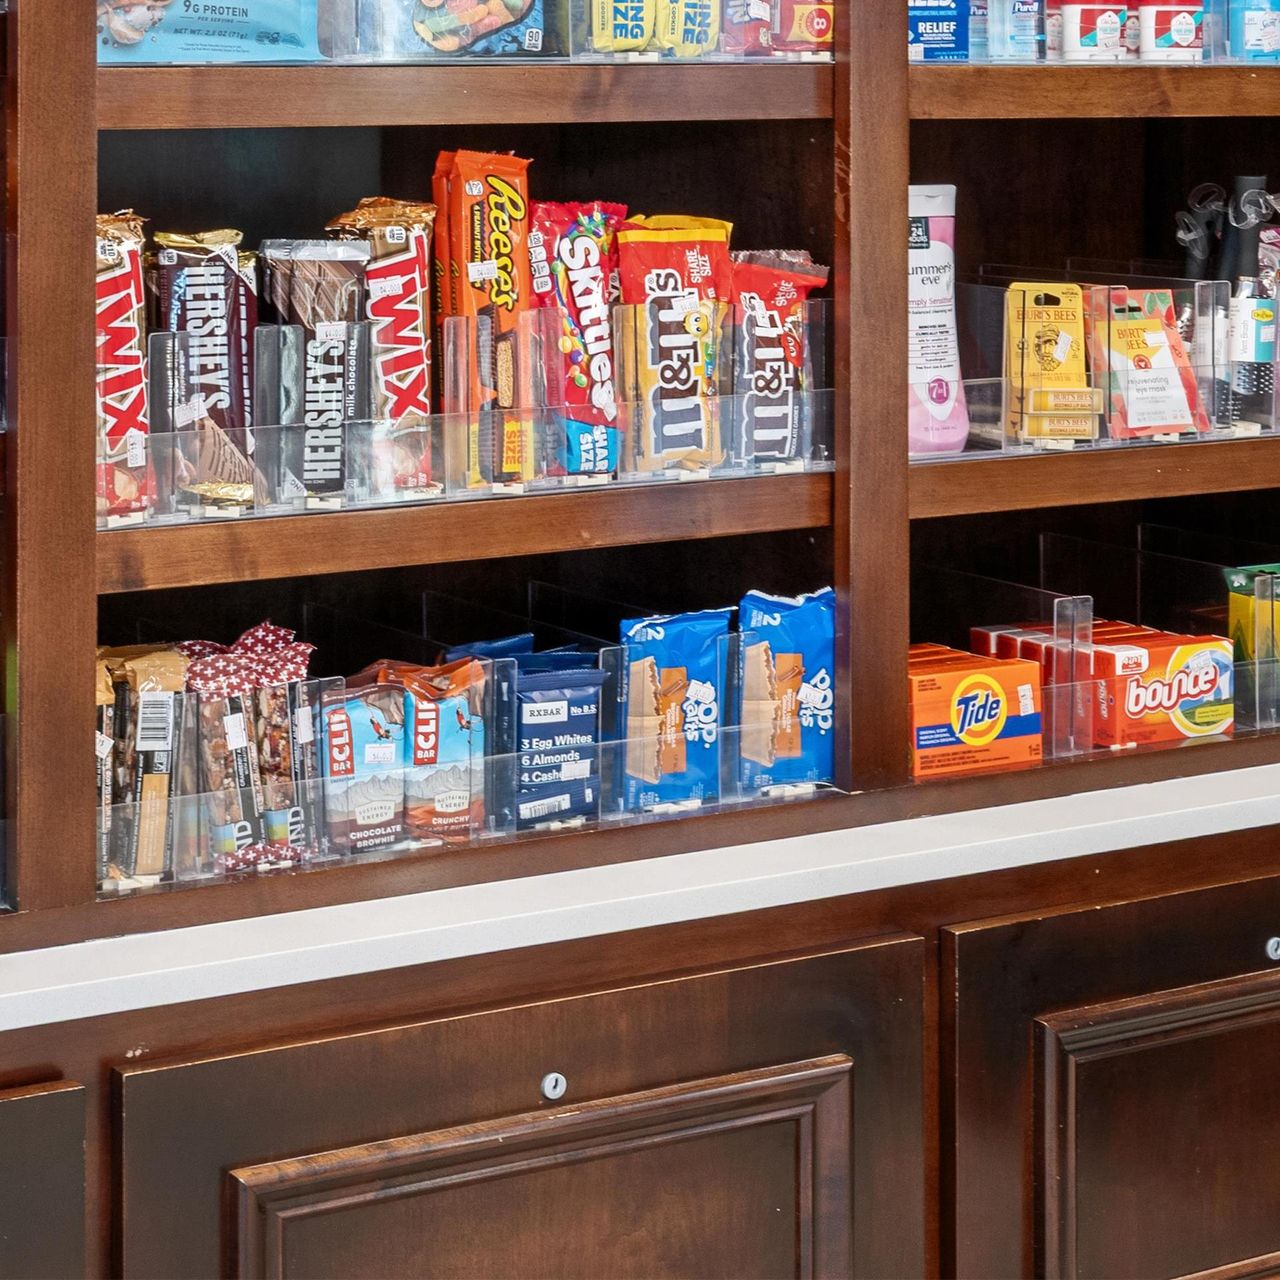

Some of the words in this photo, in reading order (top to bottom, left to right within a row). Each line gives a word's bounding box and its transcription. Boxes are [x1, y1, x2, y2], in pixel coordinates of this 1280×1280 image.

[203, 3, 249, 18] PROTEIN
[918, 22, 957, 33] RELIEF
[486, 175, 526, 311] Reese's
[1017, 310, 1051, 322] BURT'S
[1054, 309, 1076, 320] BEES
[185, 266, 230, 409] HERSHEY'S
[559, 235, 615, 422] Skittles
[347, 340, 357, 391] chocolate
[303, 339, 344, 480] HERSHEY'S
[347, 393, 356, 416] milk
[1127, 662, 1219, 718] bounce
[528, 707, 563, 717] RXBAR
[956, 691, 1001, 738] Tide
[532, 738, 552, 751] Egg
[555, 733, 592, 746] Whites
[533, 751, 580, 763] Almonds
[350, 824, 402, 839] CHOCOLATE
[356, 836, 396, 848] BROWNIE
